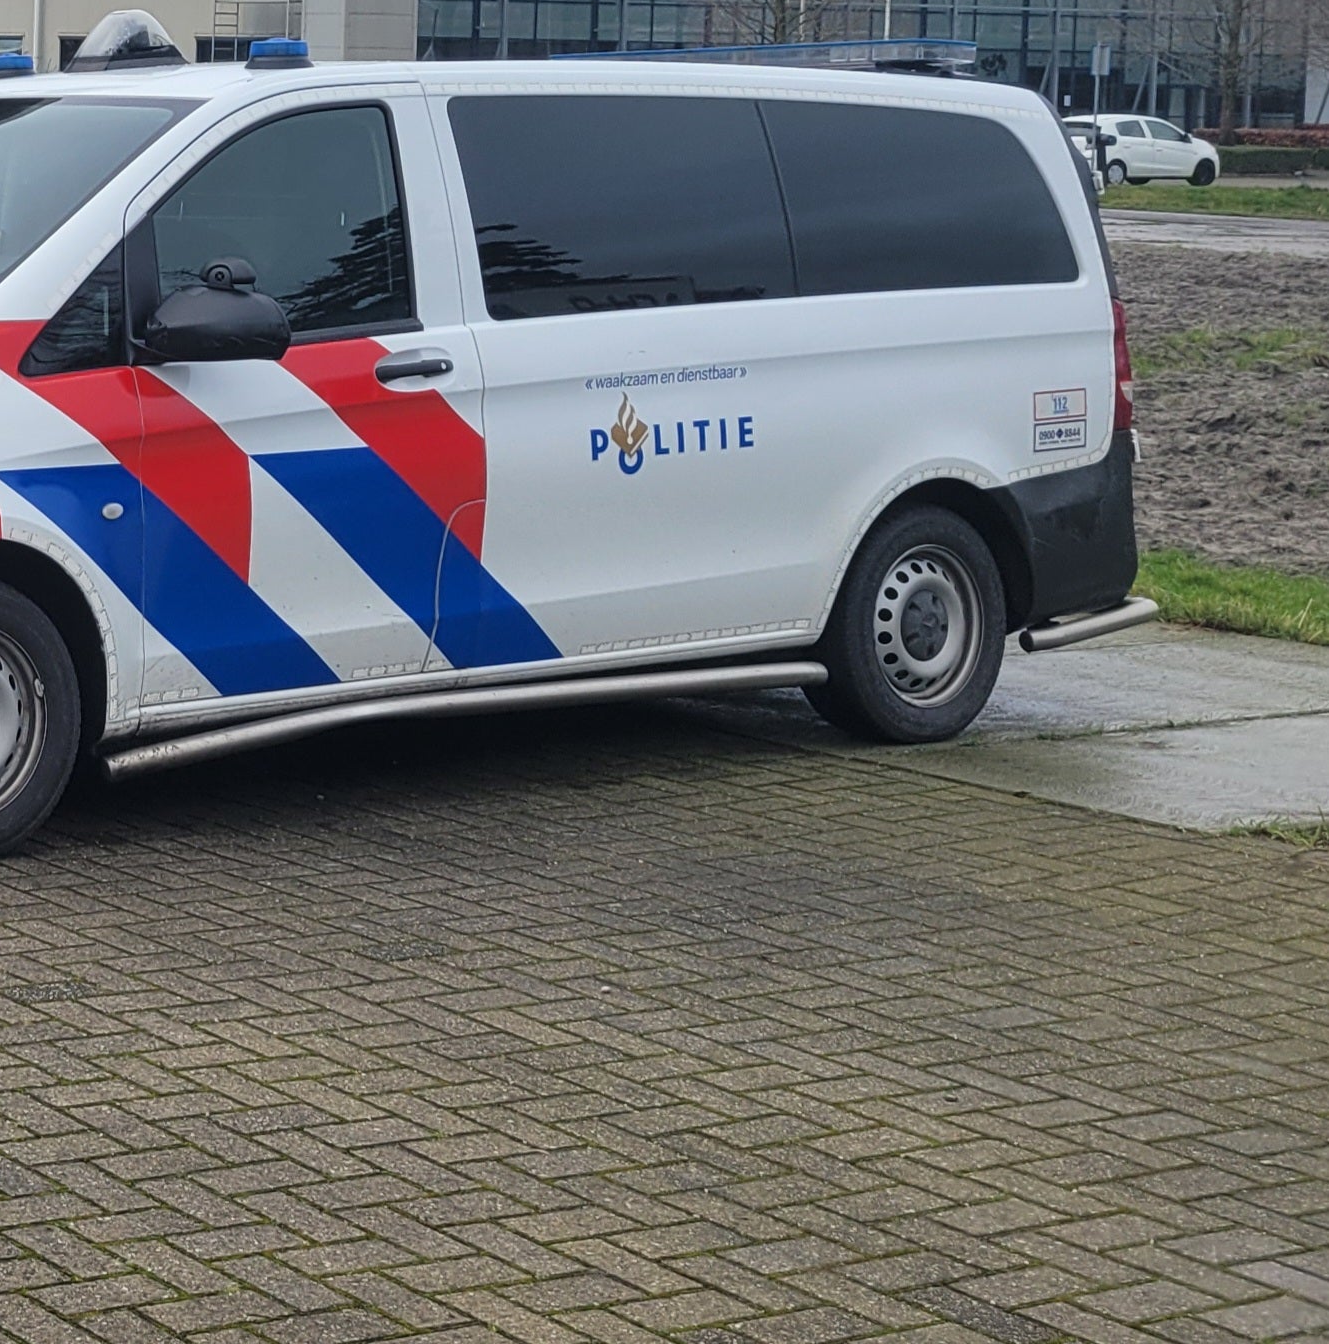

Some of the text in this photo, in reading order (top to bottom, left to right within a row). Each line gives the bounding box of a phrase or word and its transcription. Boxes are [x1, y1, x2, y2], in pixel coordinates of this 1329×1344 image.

[595, 372, 659, 389] waakzaam
[660, 373, 676, 385] en
[677, 365, 739, 383] dienstbaar
[1053, 396, 1068, 410] 112
[1039, 429, 1056, 441] 0900
[590, 416, 755, 475] POLITIE
